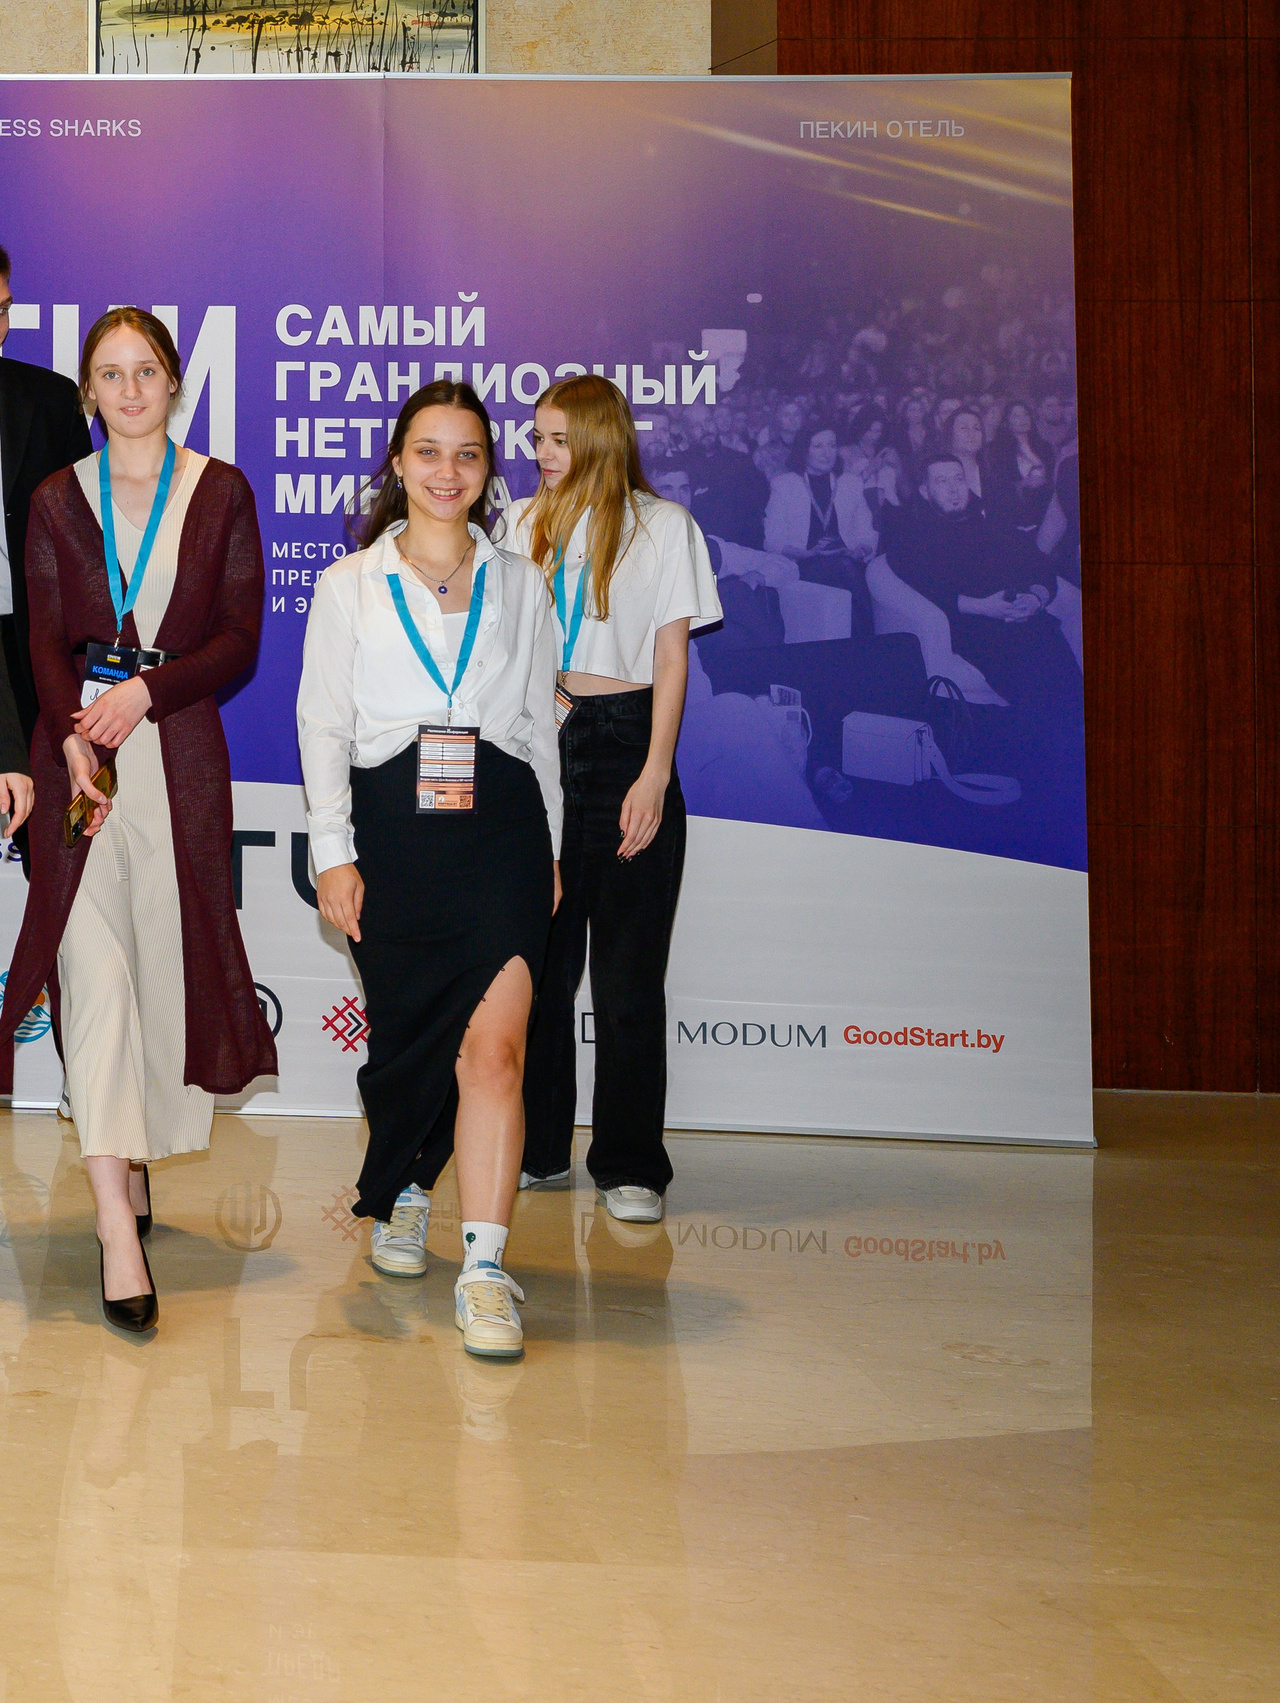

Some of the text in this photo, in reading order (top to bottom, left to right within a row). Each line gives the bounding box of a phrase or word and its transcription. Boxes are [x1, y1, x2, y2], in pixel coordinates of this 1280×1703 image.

[49, 119, 142, 137] SHARKS
[800, 120, 965, 138] ПЕКИН ОТЕЛЬ
[275, 291, 486, 346] САМЫЙ
[272, 542, 347, 560] МЕСТО
[272, 596, 285, 613] И
[92, 665, 129, 680] КОМАНДА
[677, 1021, 1005, 1054] MODUM GoodStart.by
